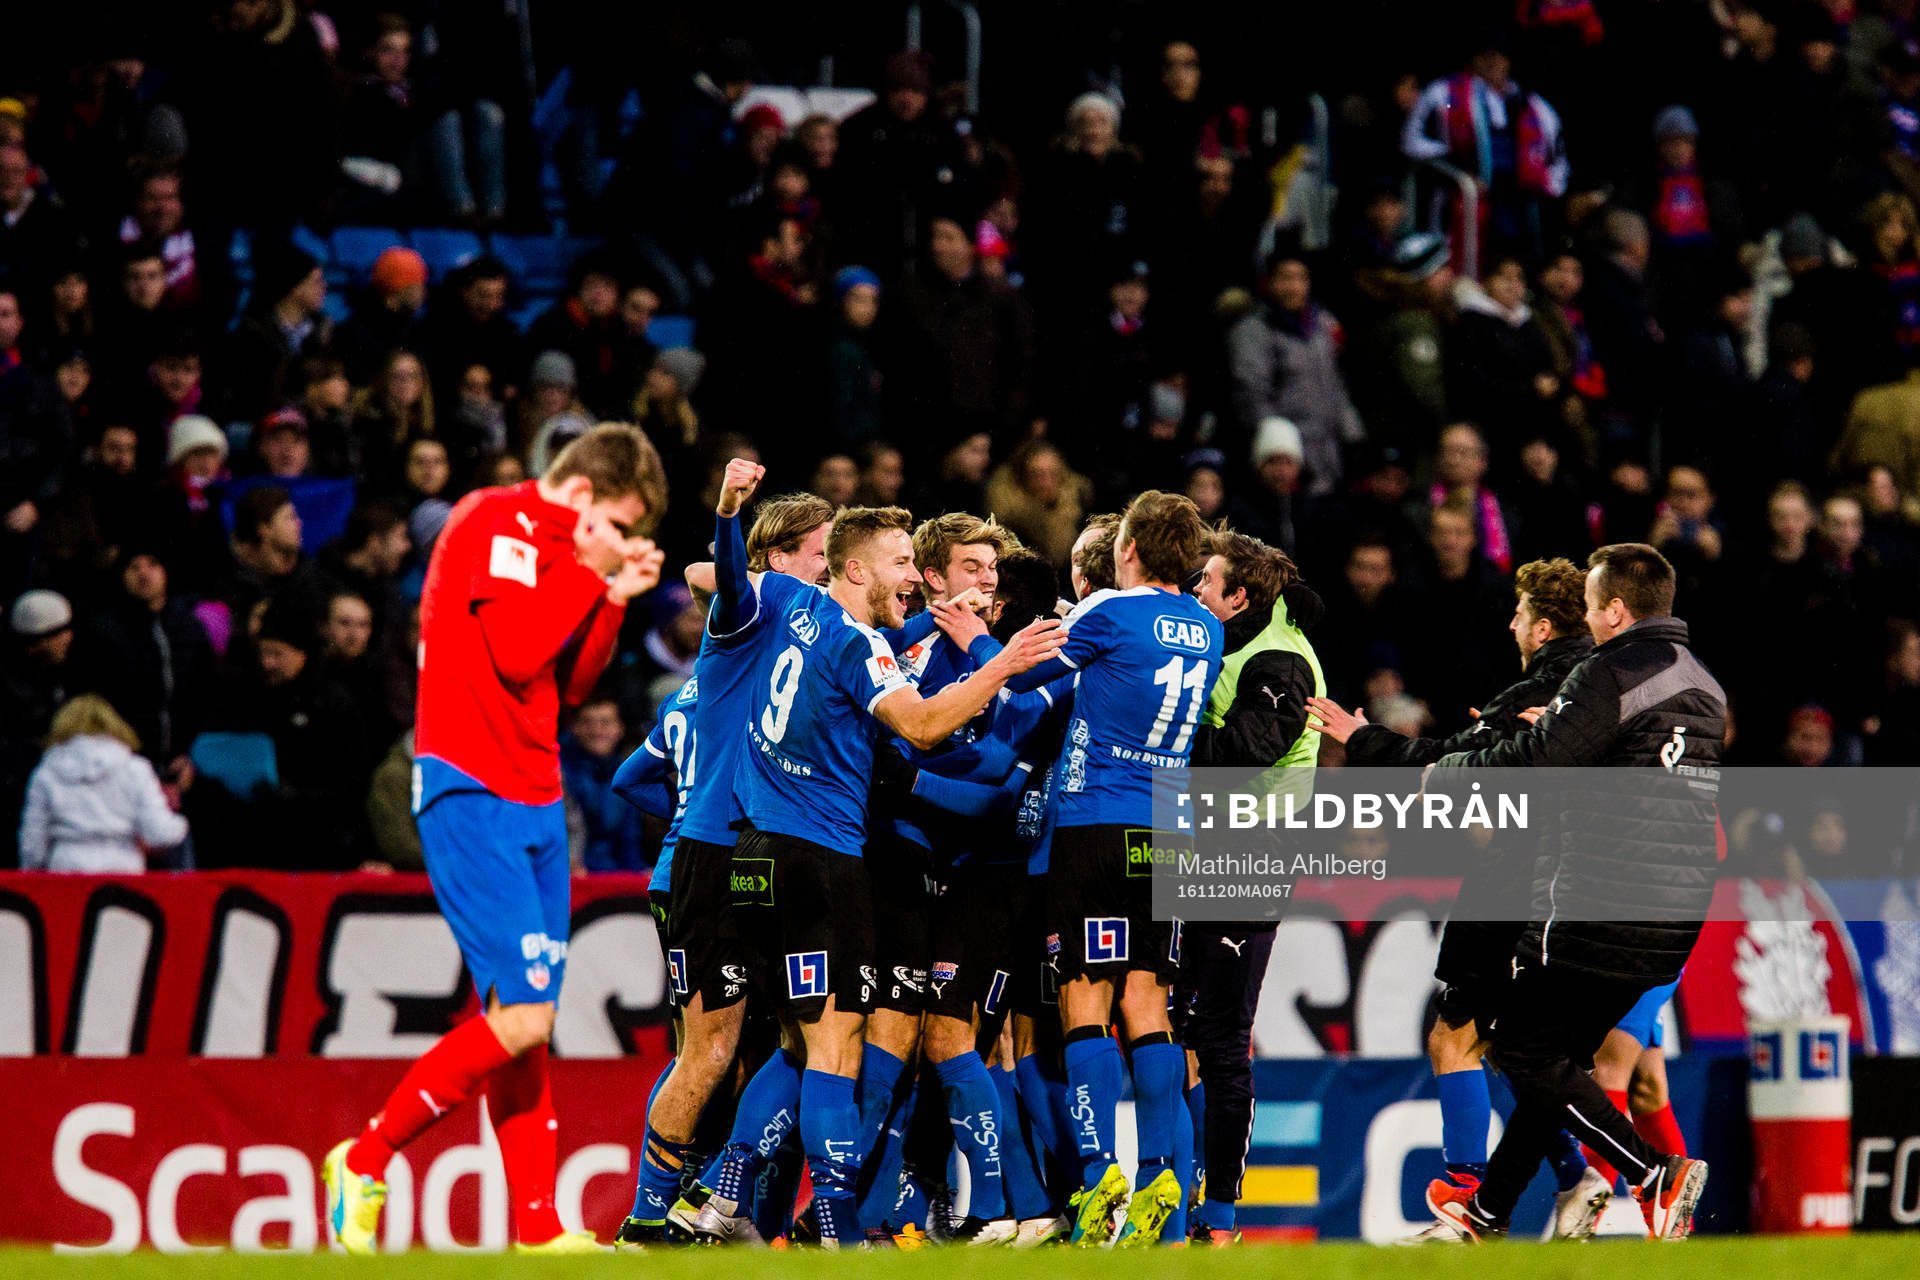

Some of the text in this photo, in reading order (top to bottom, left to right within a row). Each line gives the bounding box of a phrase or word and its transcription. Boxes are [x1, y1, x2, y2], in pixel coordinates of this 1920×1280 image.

[1160, 619, 1206, 649] EAB
[761, 645, 804, 744] 9
[1145, 655, 1209, 752] 11
[1129, 841, 1176, 865] akea
[724, 984, 740, 998] 26
[860, 984, 870, 1003] 9
[891, 985, 901, 999] 6
[1070, 1083, 1101, 1152] LinSon
[973, 1109, 1002, 1178] LinSon
[52, 1093, 631, 1253] Scadc
